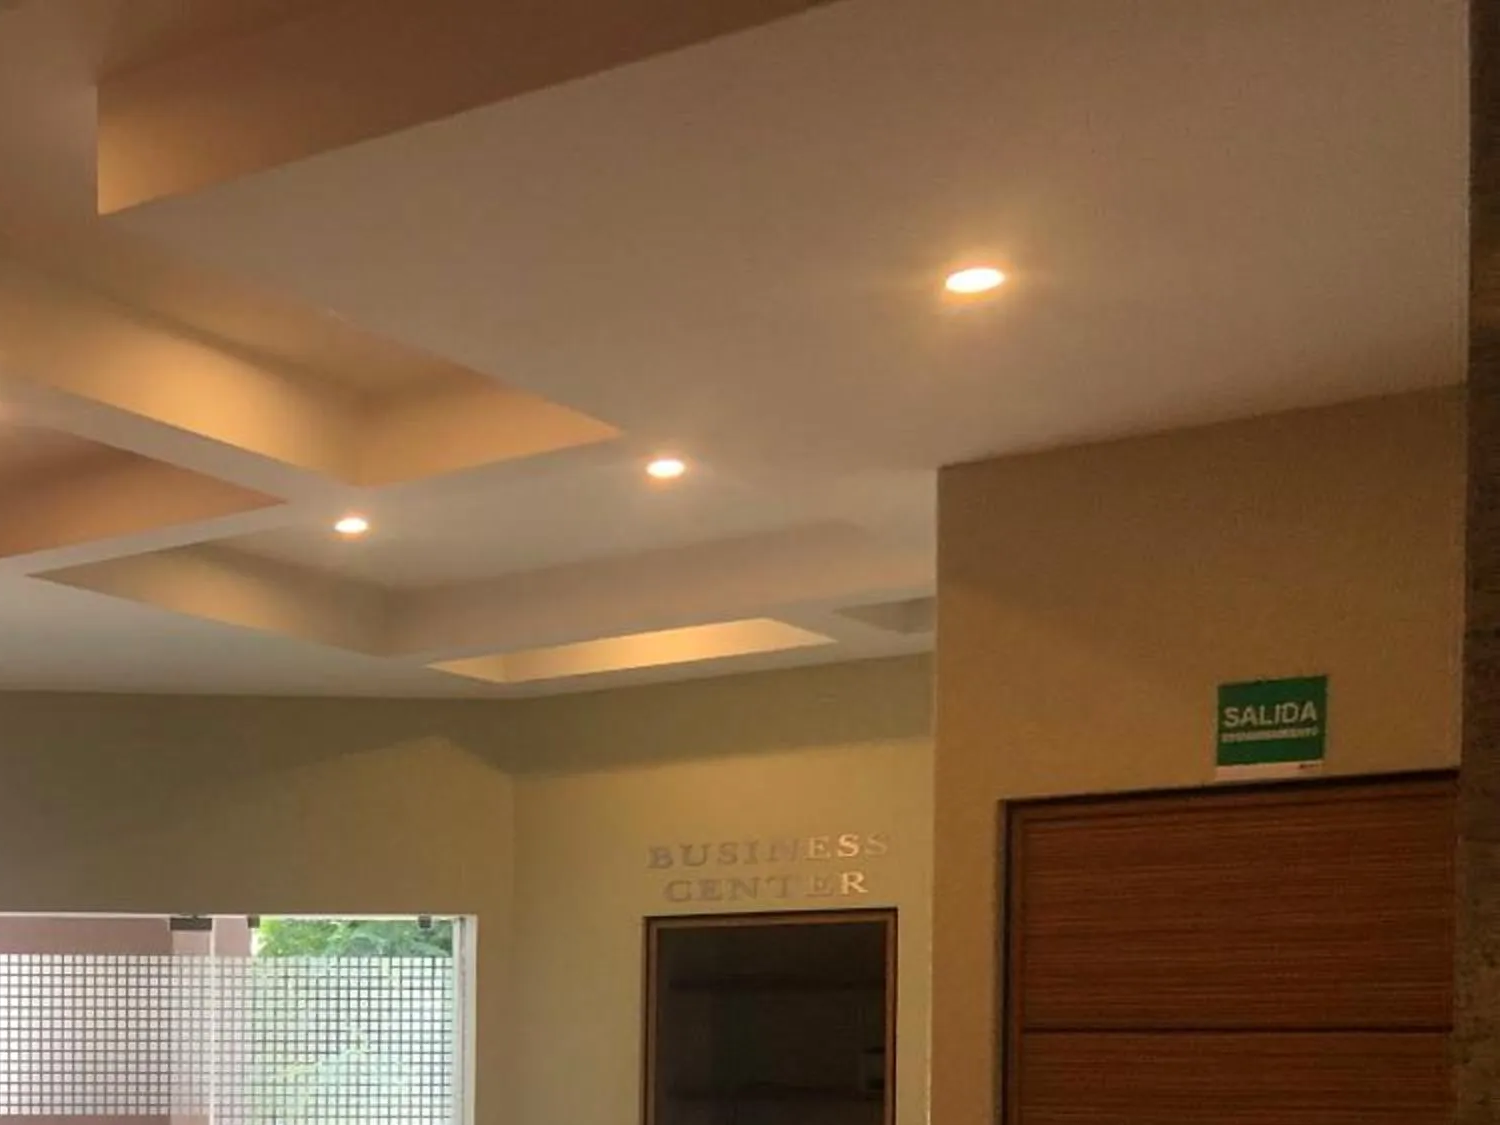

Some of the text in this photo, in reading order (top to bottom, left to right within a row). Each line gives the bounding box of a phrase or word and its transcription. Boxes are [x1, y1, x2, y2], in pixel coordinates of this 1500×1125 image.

[1223, 700, 1317, 728] SALIDA
[648, 832, 891, 869] BUSINESS
[663, 870, 868, 902] CENTER
